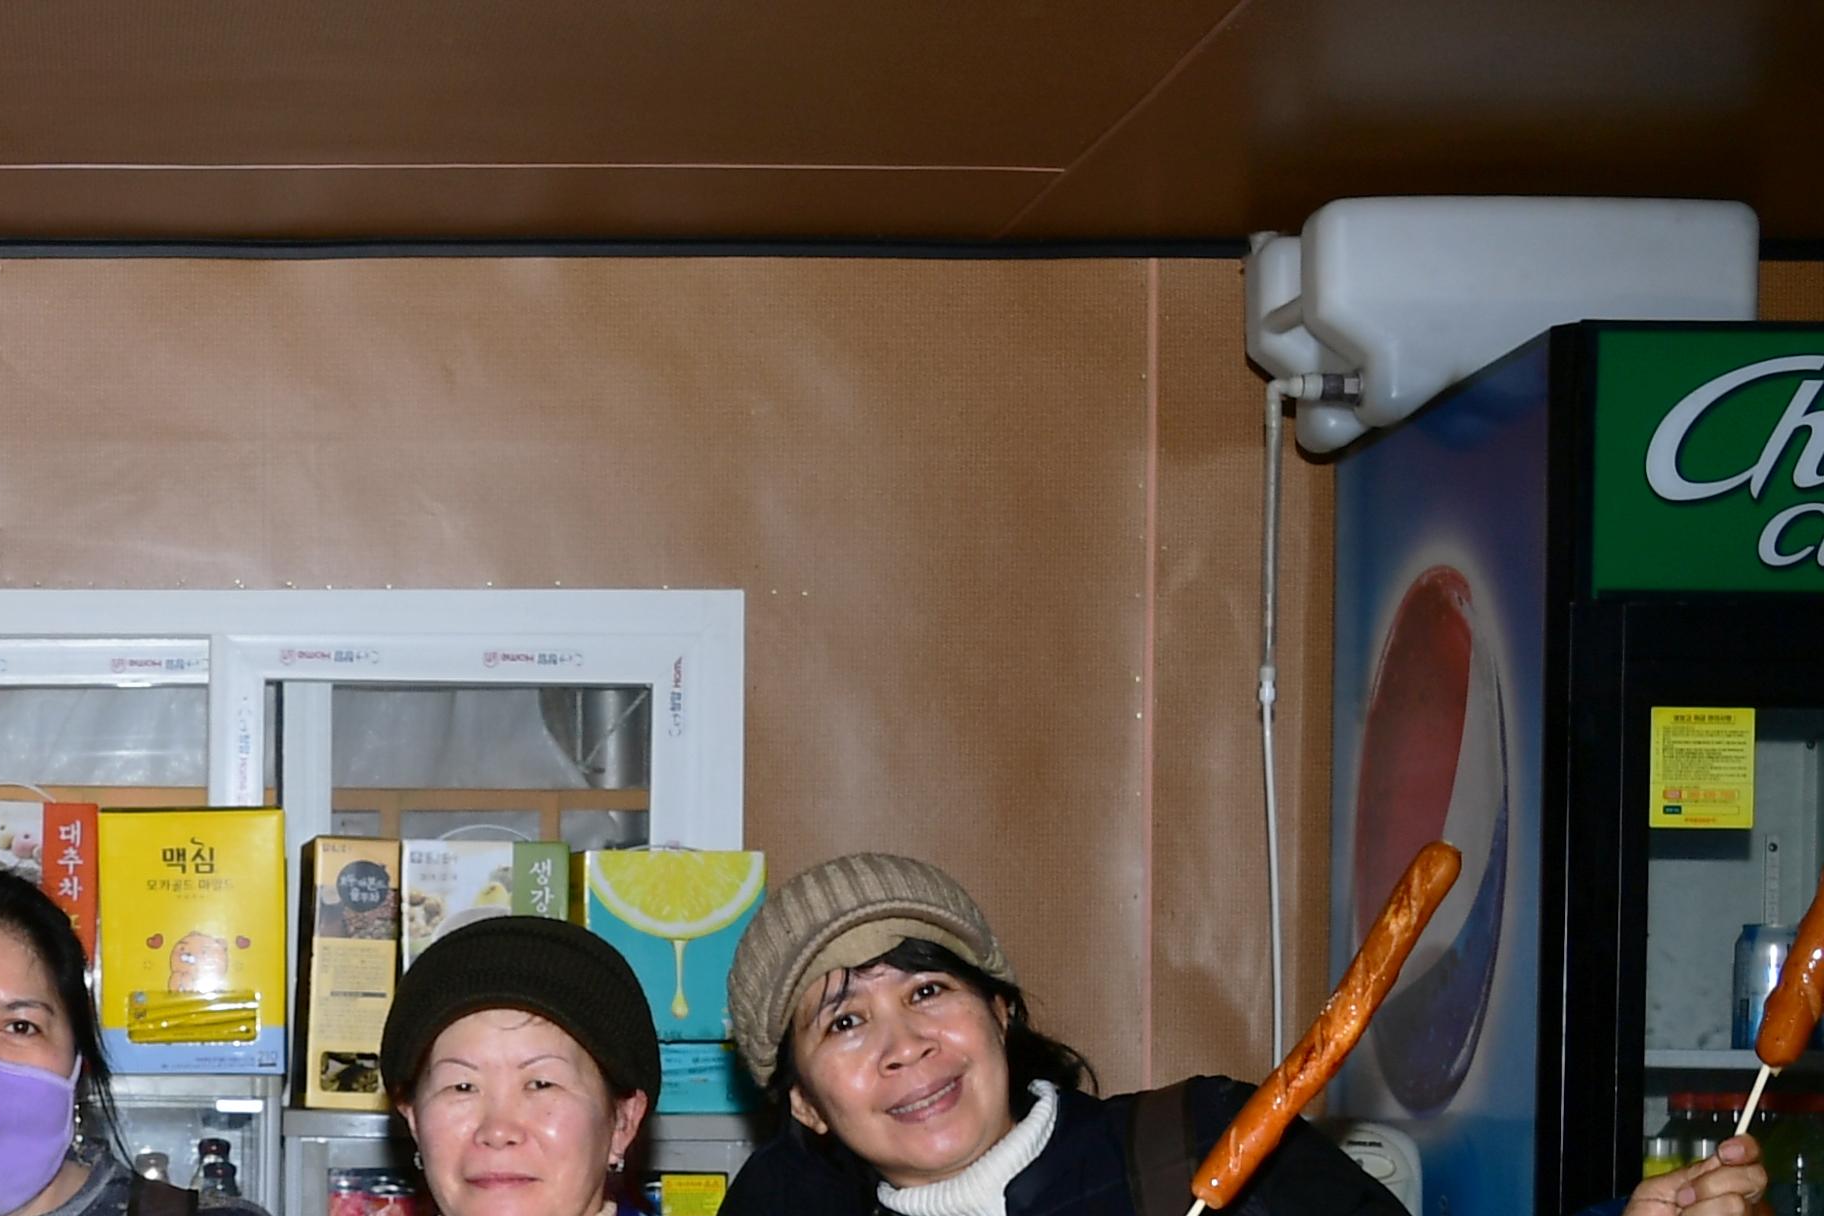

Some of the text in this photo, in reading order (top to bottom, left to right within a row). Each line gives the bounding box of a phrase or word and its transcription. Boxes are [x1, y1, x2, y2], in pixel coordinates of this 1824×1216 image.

[1758, 502, 1824, 567] C
[57, 819, 84, 902] 대추차
[162, 836, 215, 874] 맥심
[528, 858, 555, 915] 생강
